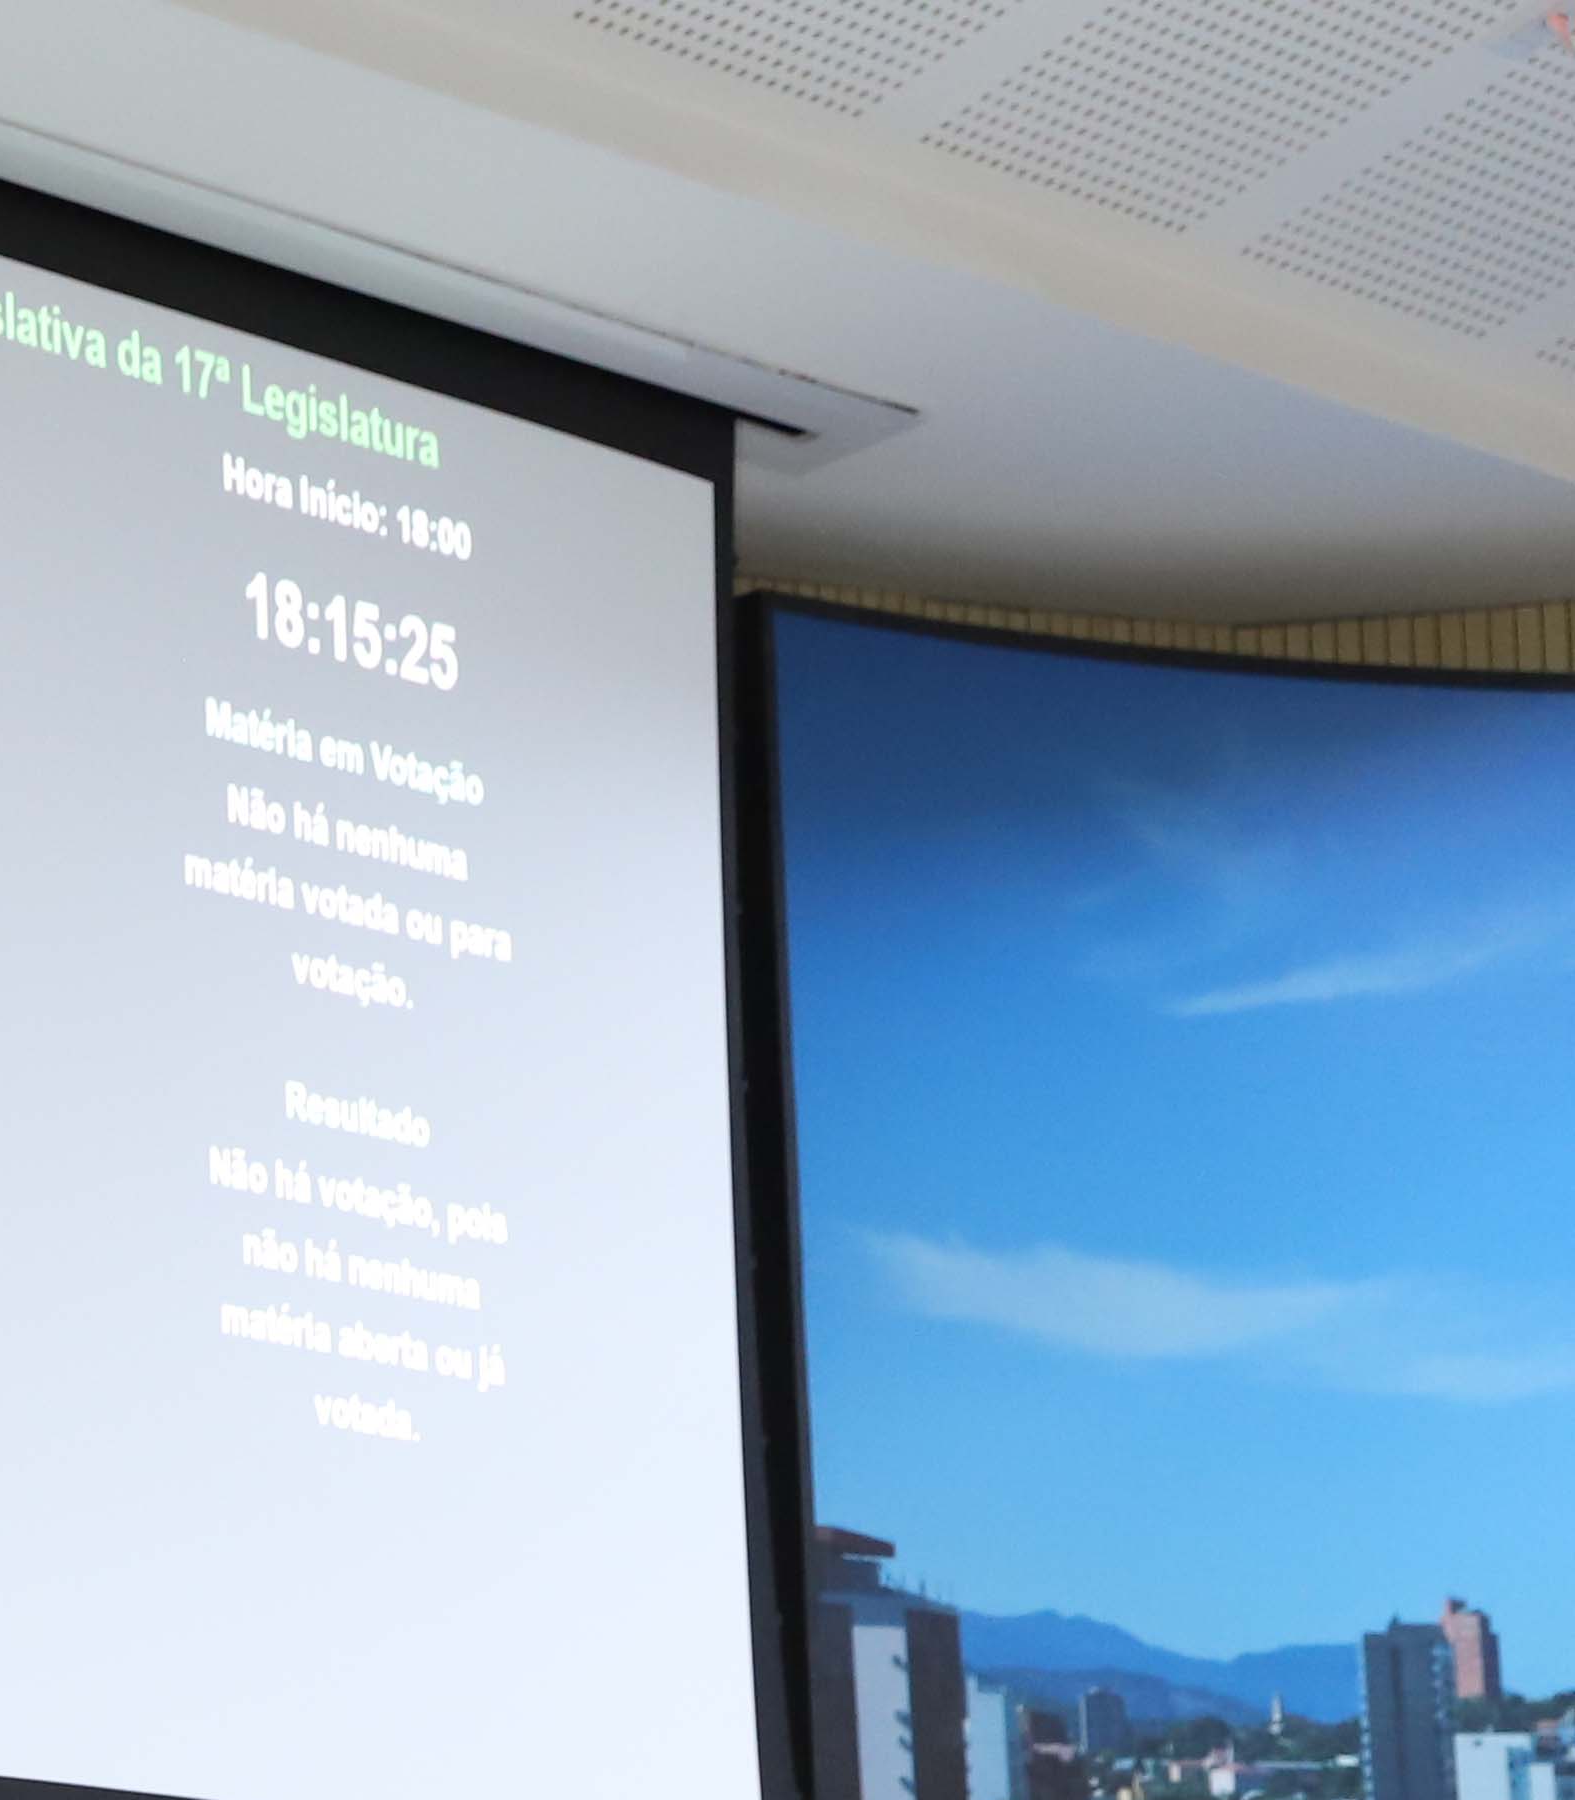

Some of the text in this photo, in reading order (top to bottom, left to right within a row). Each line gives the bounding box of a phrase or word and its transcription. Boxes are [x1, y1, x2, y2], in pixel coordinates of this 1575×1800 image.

[118, 330, 162, 385] da
[241, 364, 439, 468] Legislatura
[222, 452, 292, 509] Hora
[397, 505, 472, 560] 18:00
[245, 572, 459, 690] 18:15:25
[205, 696, 485, 806] Matéria em Votação
[227, 783, 469, 881] Não há nenhuma
[184, 854, 513, 962] matéria votada ou para
[285, 1079, 431, 1148] Resultado
[208, 1145, 268, 1195] Não
[275, 1158, 312, 1204] há
[447, 1202, 508, 1244] pois
[242, 1228, 481, 1310] não há nenhuma
[338, 1320, 429, 1372] aberta
[435, 1344, 472, 1380] ou
